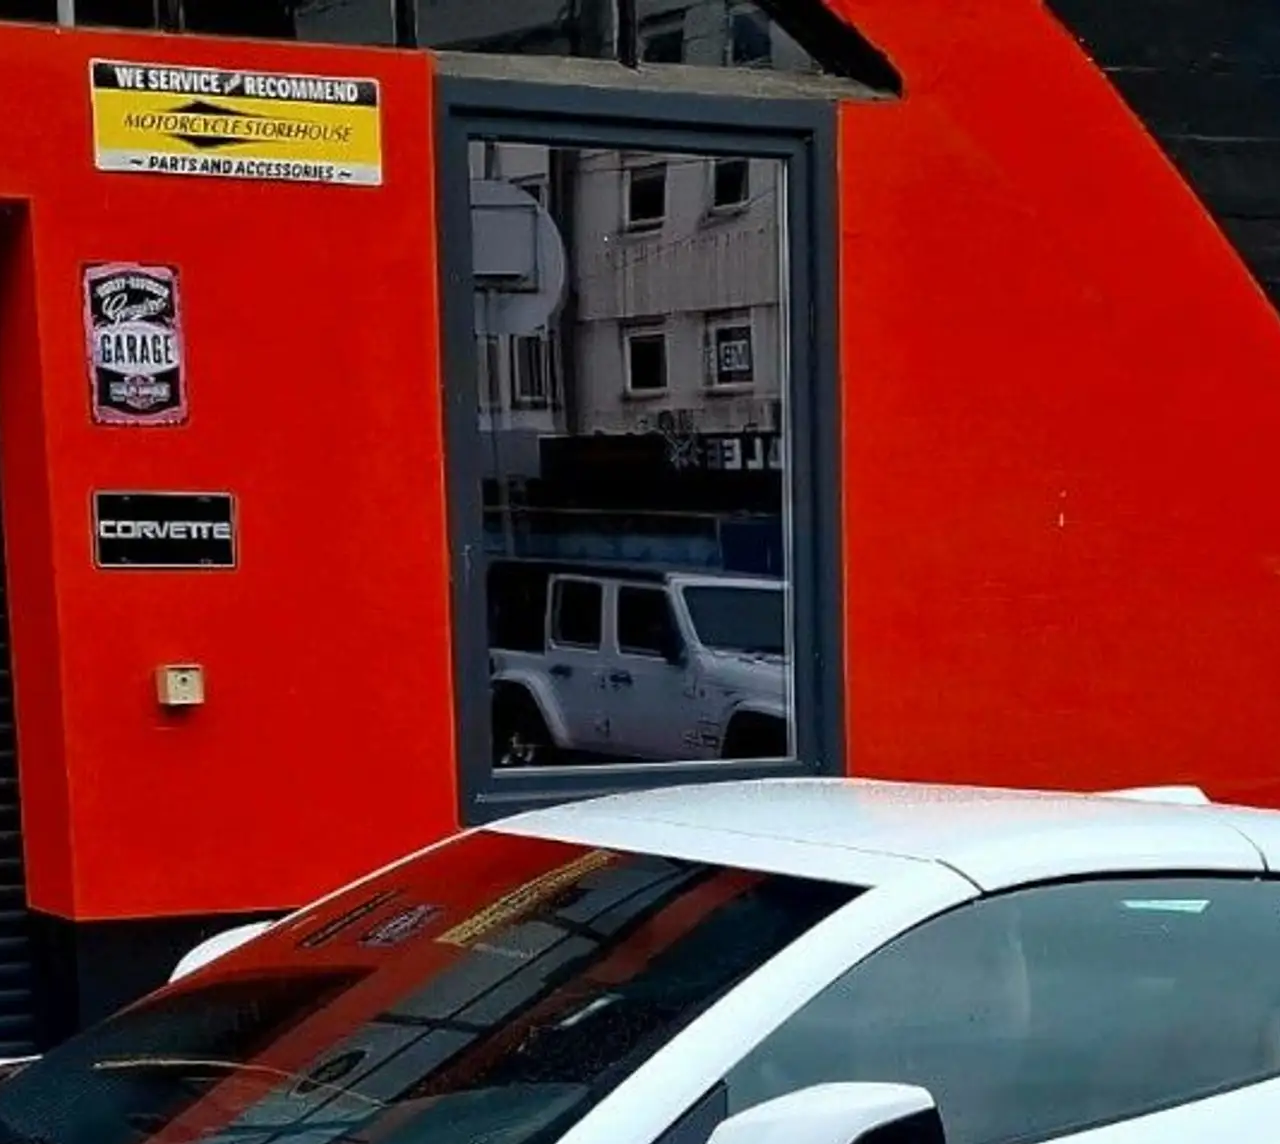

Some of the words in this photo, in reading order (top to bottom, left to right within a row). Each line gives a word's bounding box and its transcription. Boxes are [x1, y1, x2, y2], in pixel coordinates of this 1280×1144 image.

[114, 67, 145, 88] WE
[148, 69, 221, 93] SERVICE
[244, 76, 358, 102] RECOMMEND
[124, 113, 239, 136] MOTORCYCLE
[243, 119, 354, 143] STOREHOUSE
[148, 155, 198, 173] PARTS
[200, 158, 232, 174] AND
[235, 159, 334, 181] ACCESSORIES
[100, 333, 173, 364] GARAGE
[99, 520, 232, 539] CORVETTE
